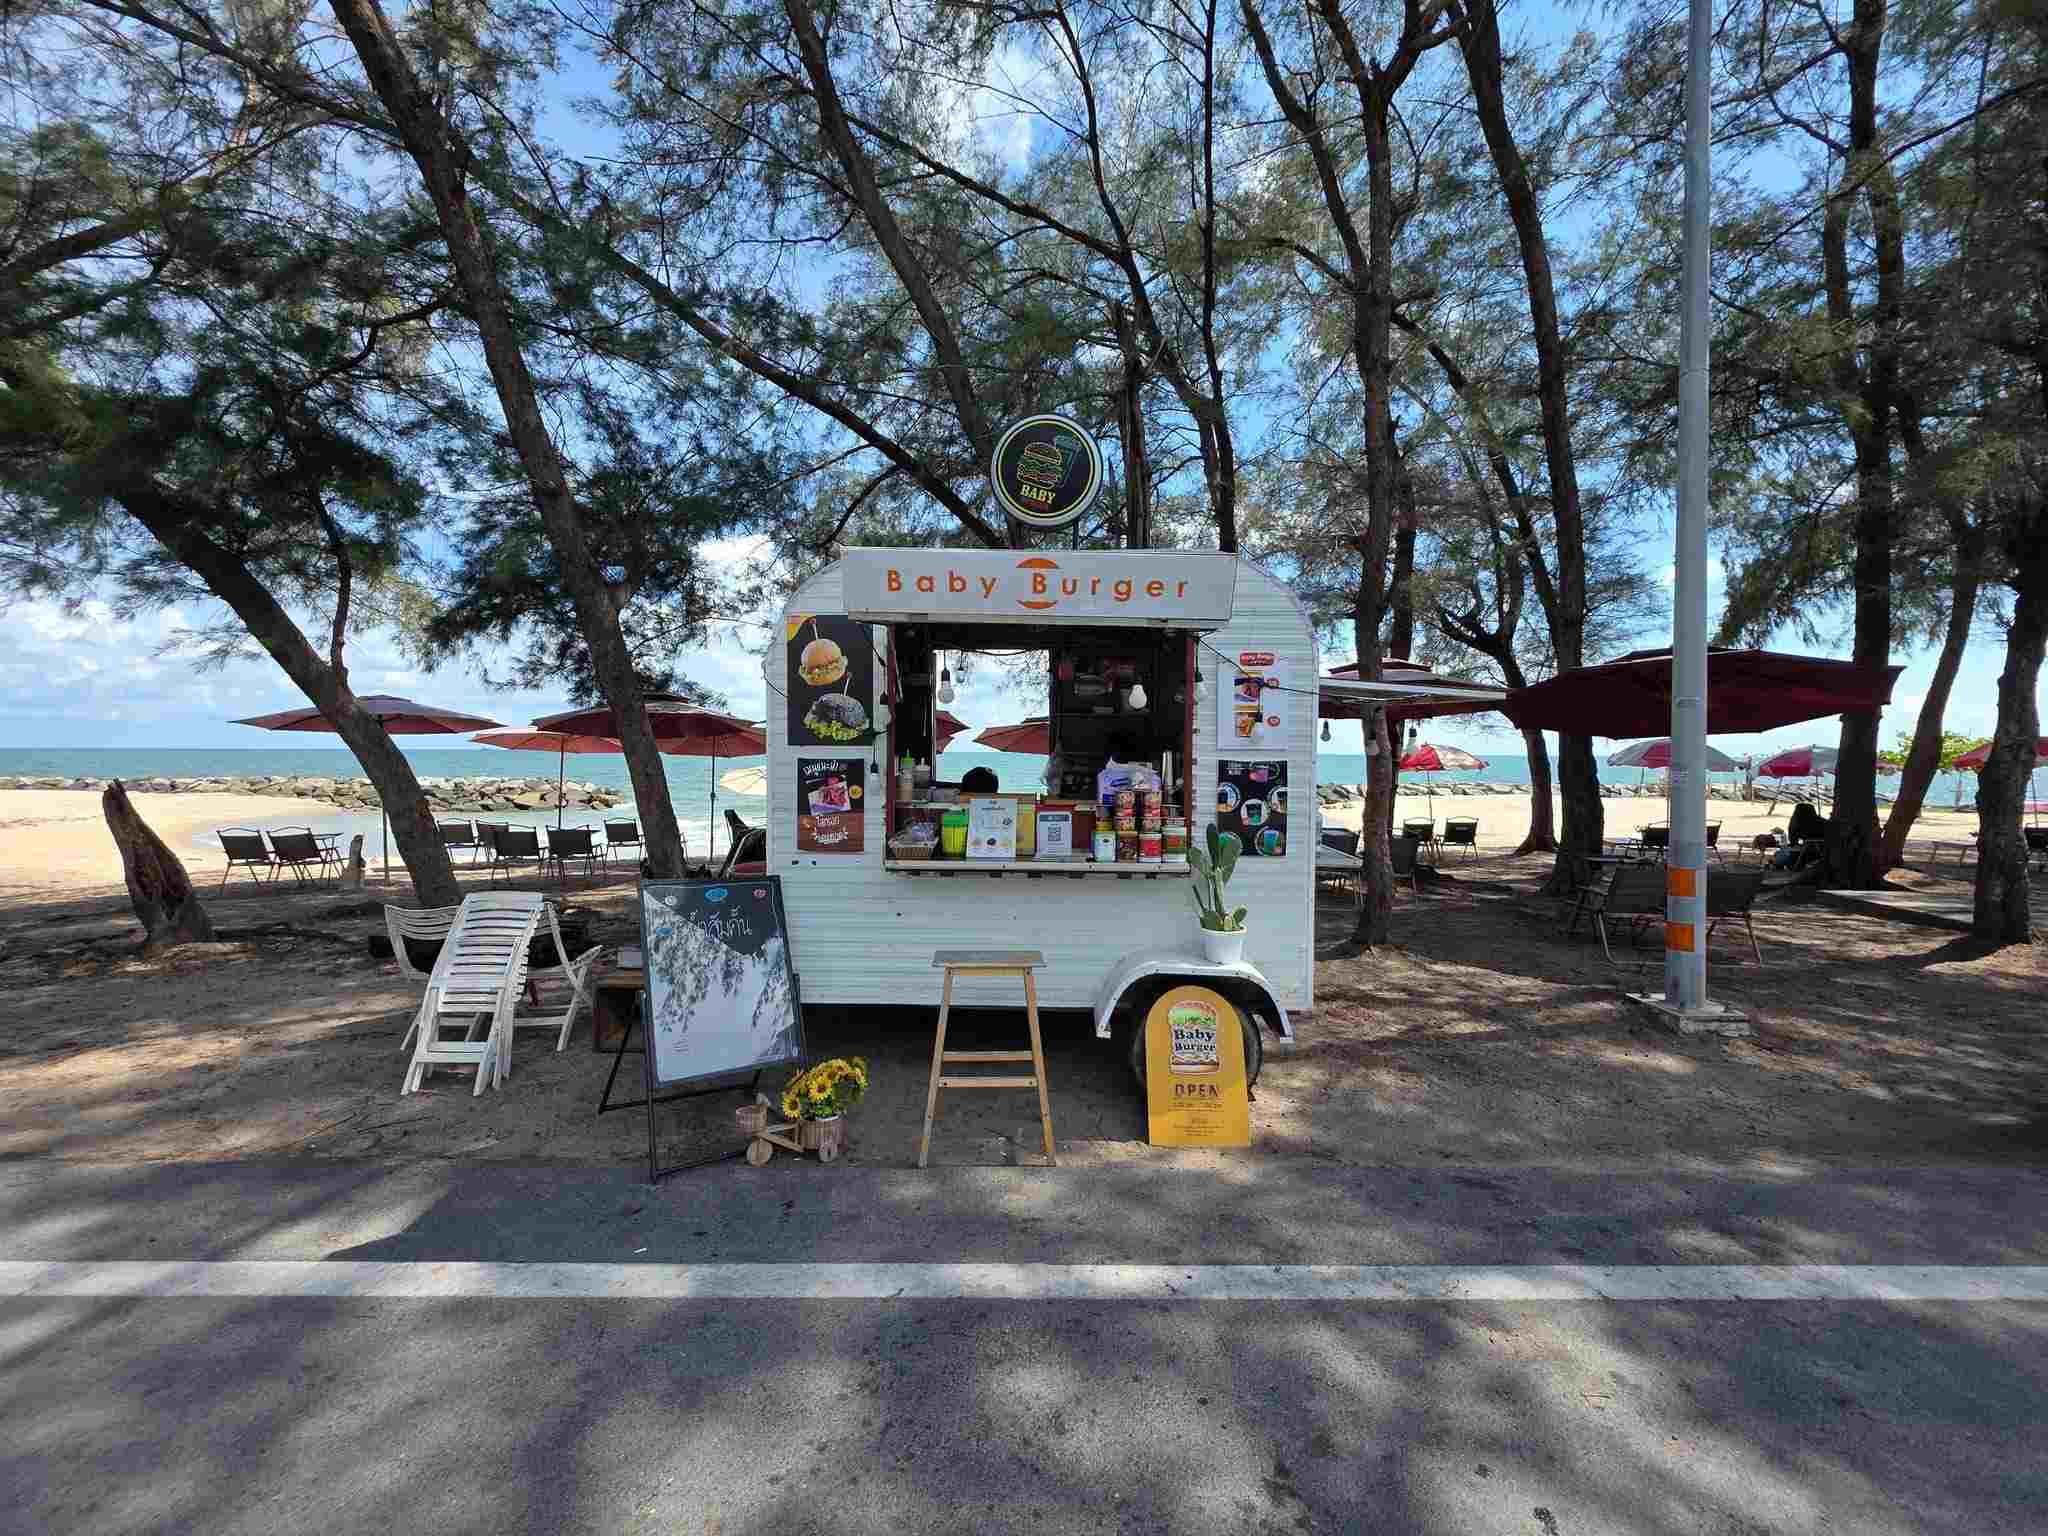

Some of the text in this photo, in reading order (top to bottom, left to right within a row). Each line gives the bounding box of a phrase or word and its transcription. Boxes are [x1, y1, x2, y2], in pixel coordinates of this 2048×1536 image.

[1020, 484, 1056, 504] BABY
[887, 568, 1189, 602] Baby Burger
[1174, 1029, 1216, 1042] Baby
[1175, 1083, 1219, 1097] OPEN
